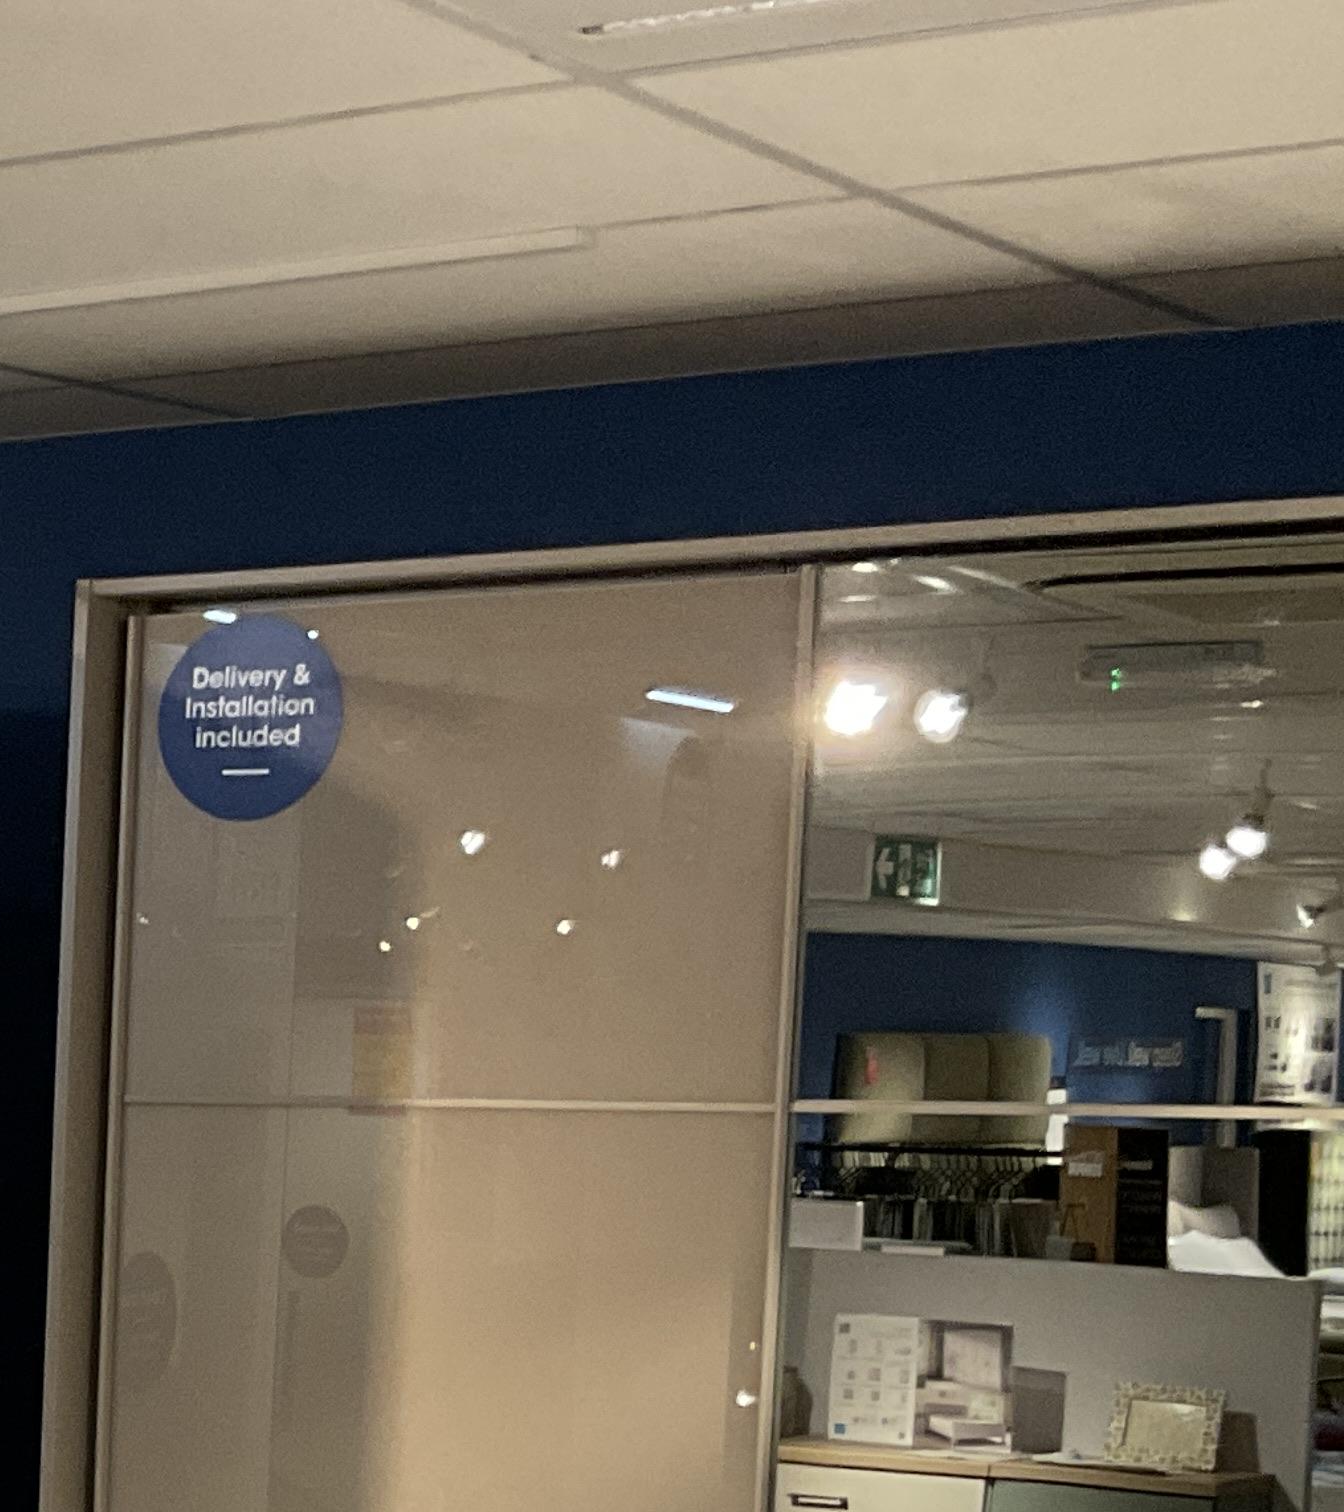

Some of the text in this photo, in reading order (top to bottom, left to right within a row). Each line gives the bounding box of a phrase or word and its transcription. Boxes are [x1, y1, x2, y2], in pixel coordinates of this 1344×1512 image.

[192, 664, 310, 691] Delivery &
[185, 694, 315, 719] Installation
[195, 723, 301, 748] included
